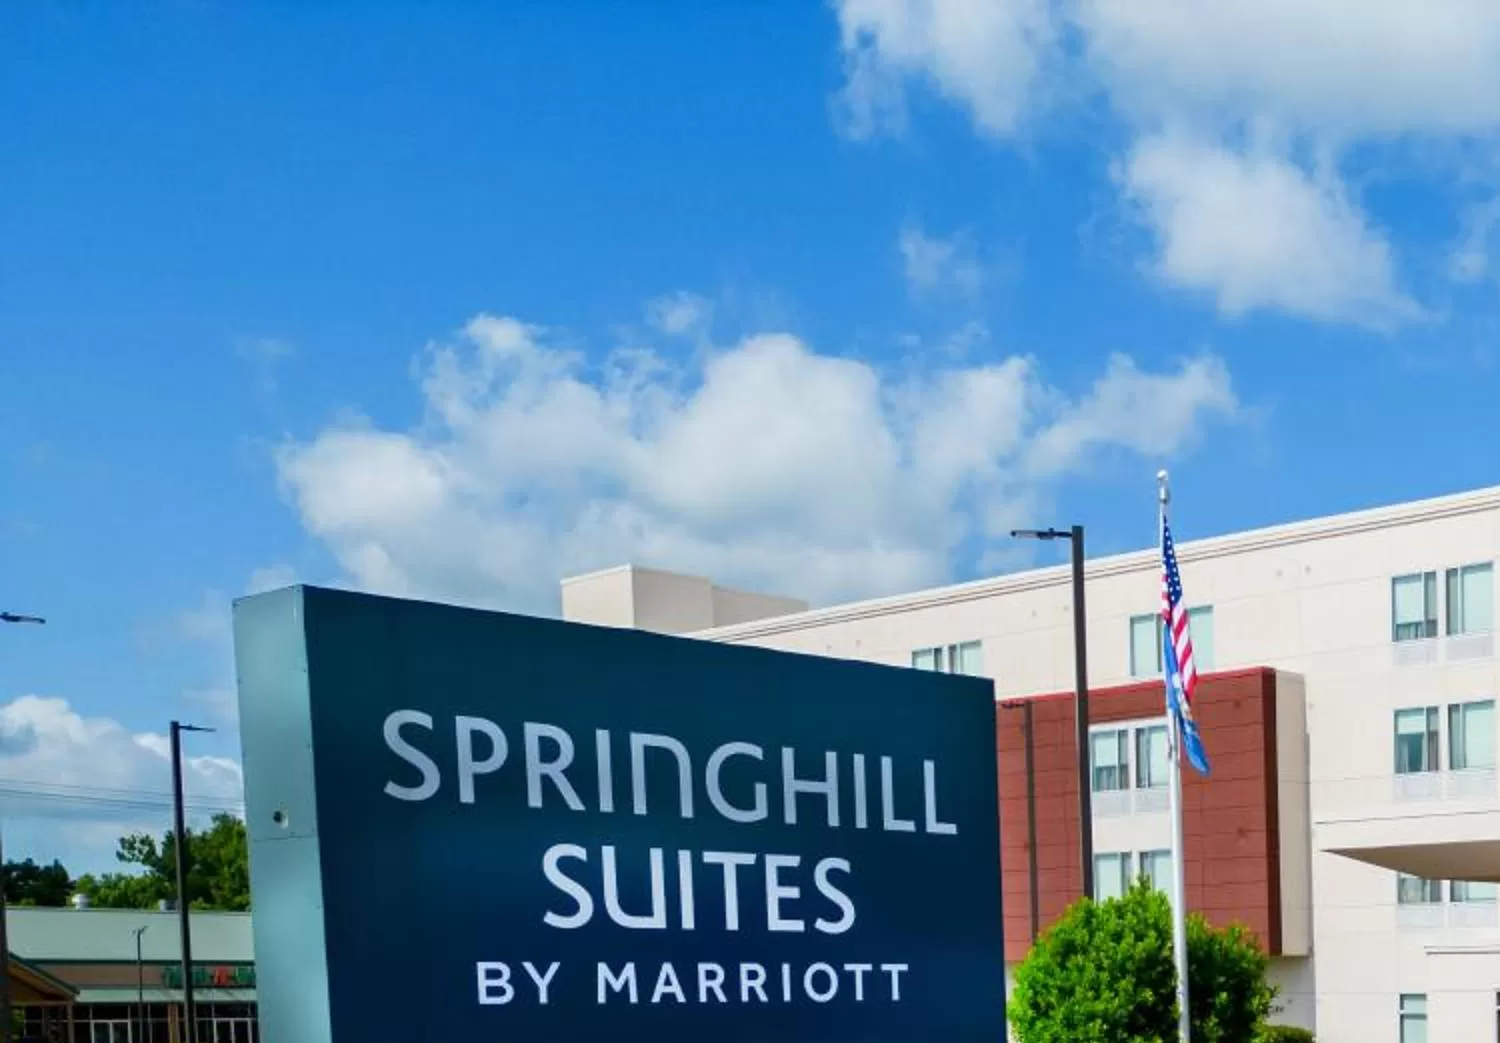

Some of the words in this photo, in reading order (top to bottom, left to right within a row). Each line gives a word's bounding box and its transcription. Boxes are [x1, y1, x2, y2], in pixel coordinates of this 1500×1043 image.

[382, 710, 958, 835] SPRINGHILL
[542, 843, 857, 935] SUITES
[476, 961, 561, 1005] BY
[597, 962, 909, 1004] MARRIOTT
